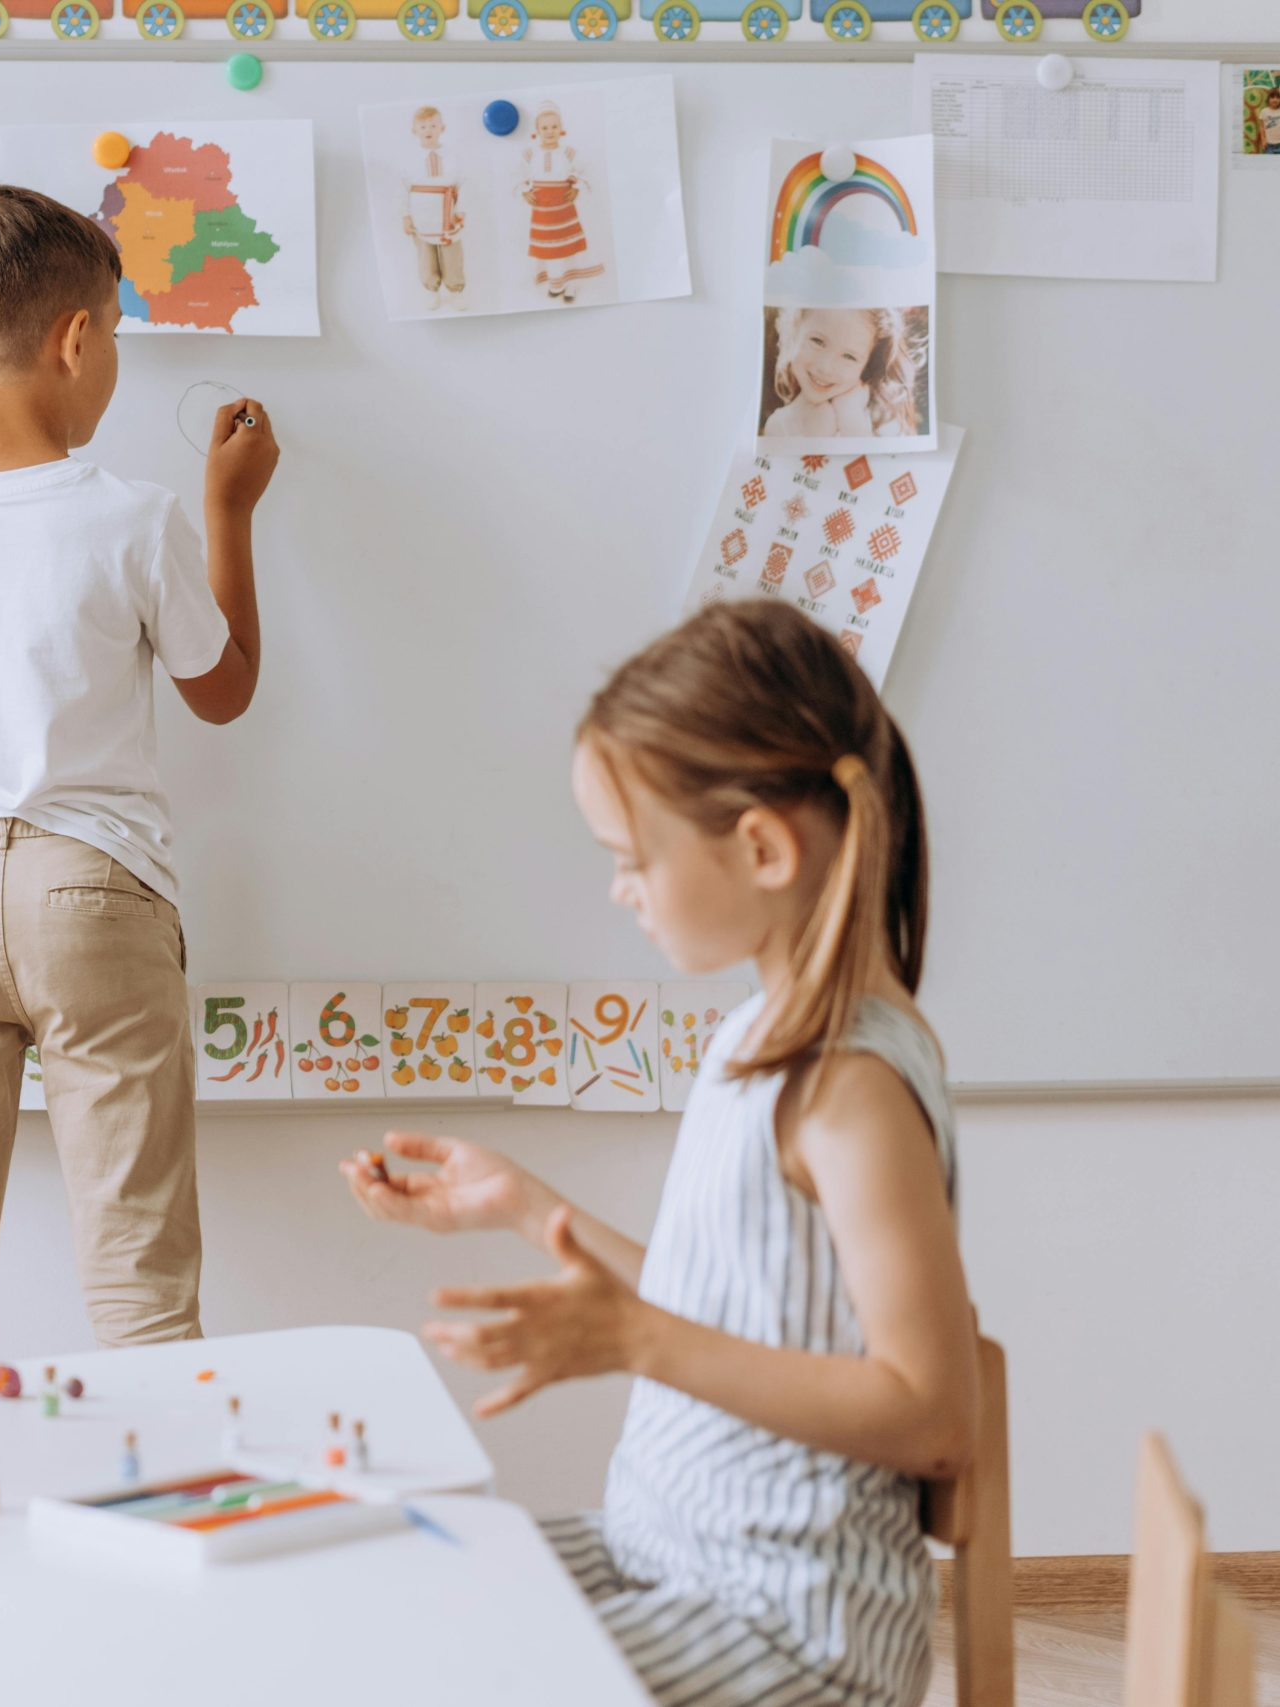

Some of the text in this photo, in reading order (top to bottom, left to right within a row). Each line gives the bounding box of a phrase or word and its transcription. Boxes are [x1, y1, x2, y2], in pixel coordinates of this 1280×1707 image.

[204, 996, 248, 1060] 5
[319, 992, 356, 1047] 6
[408, 998, 450, 1050] 7
[503, 1017, 536, 1066] 8
[594, 993, 630, 1046] 9
